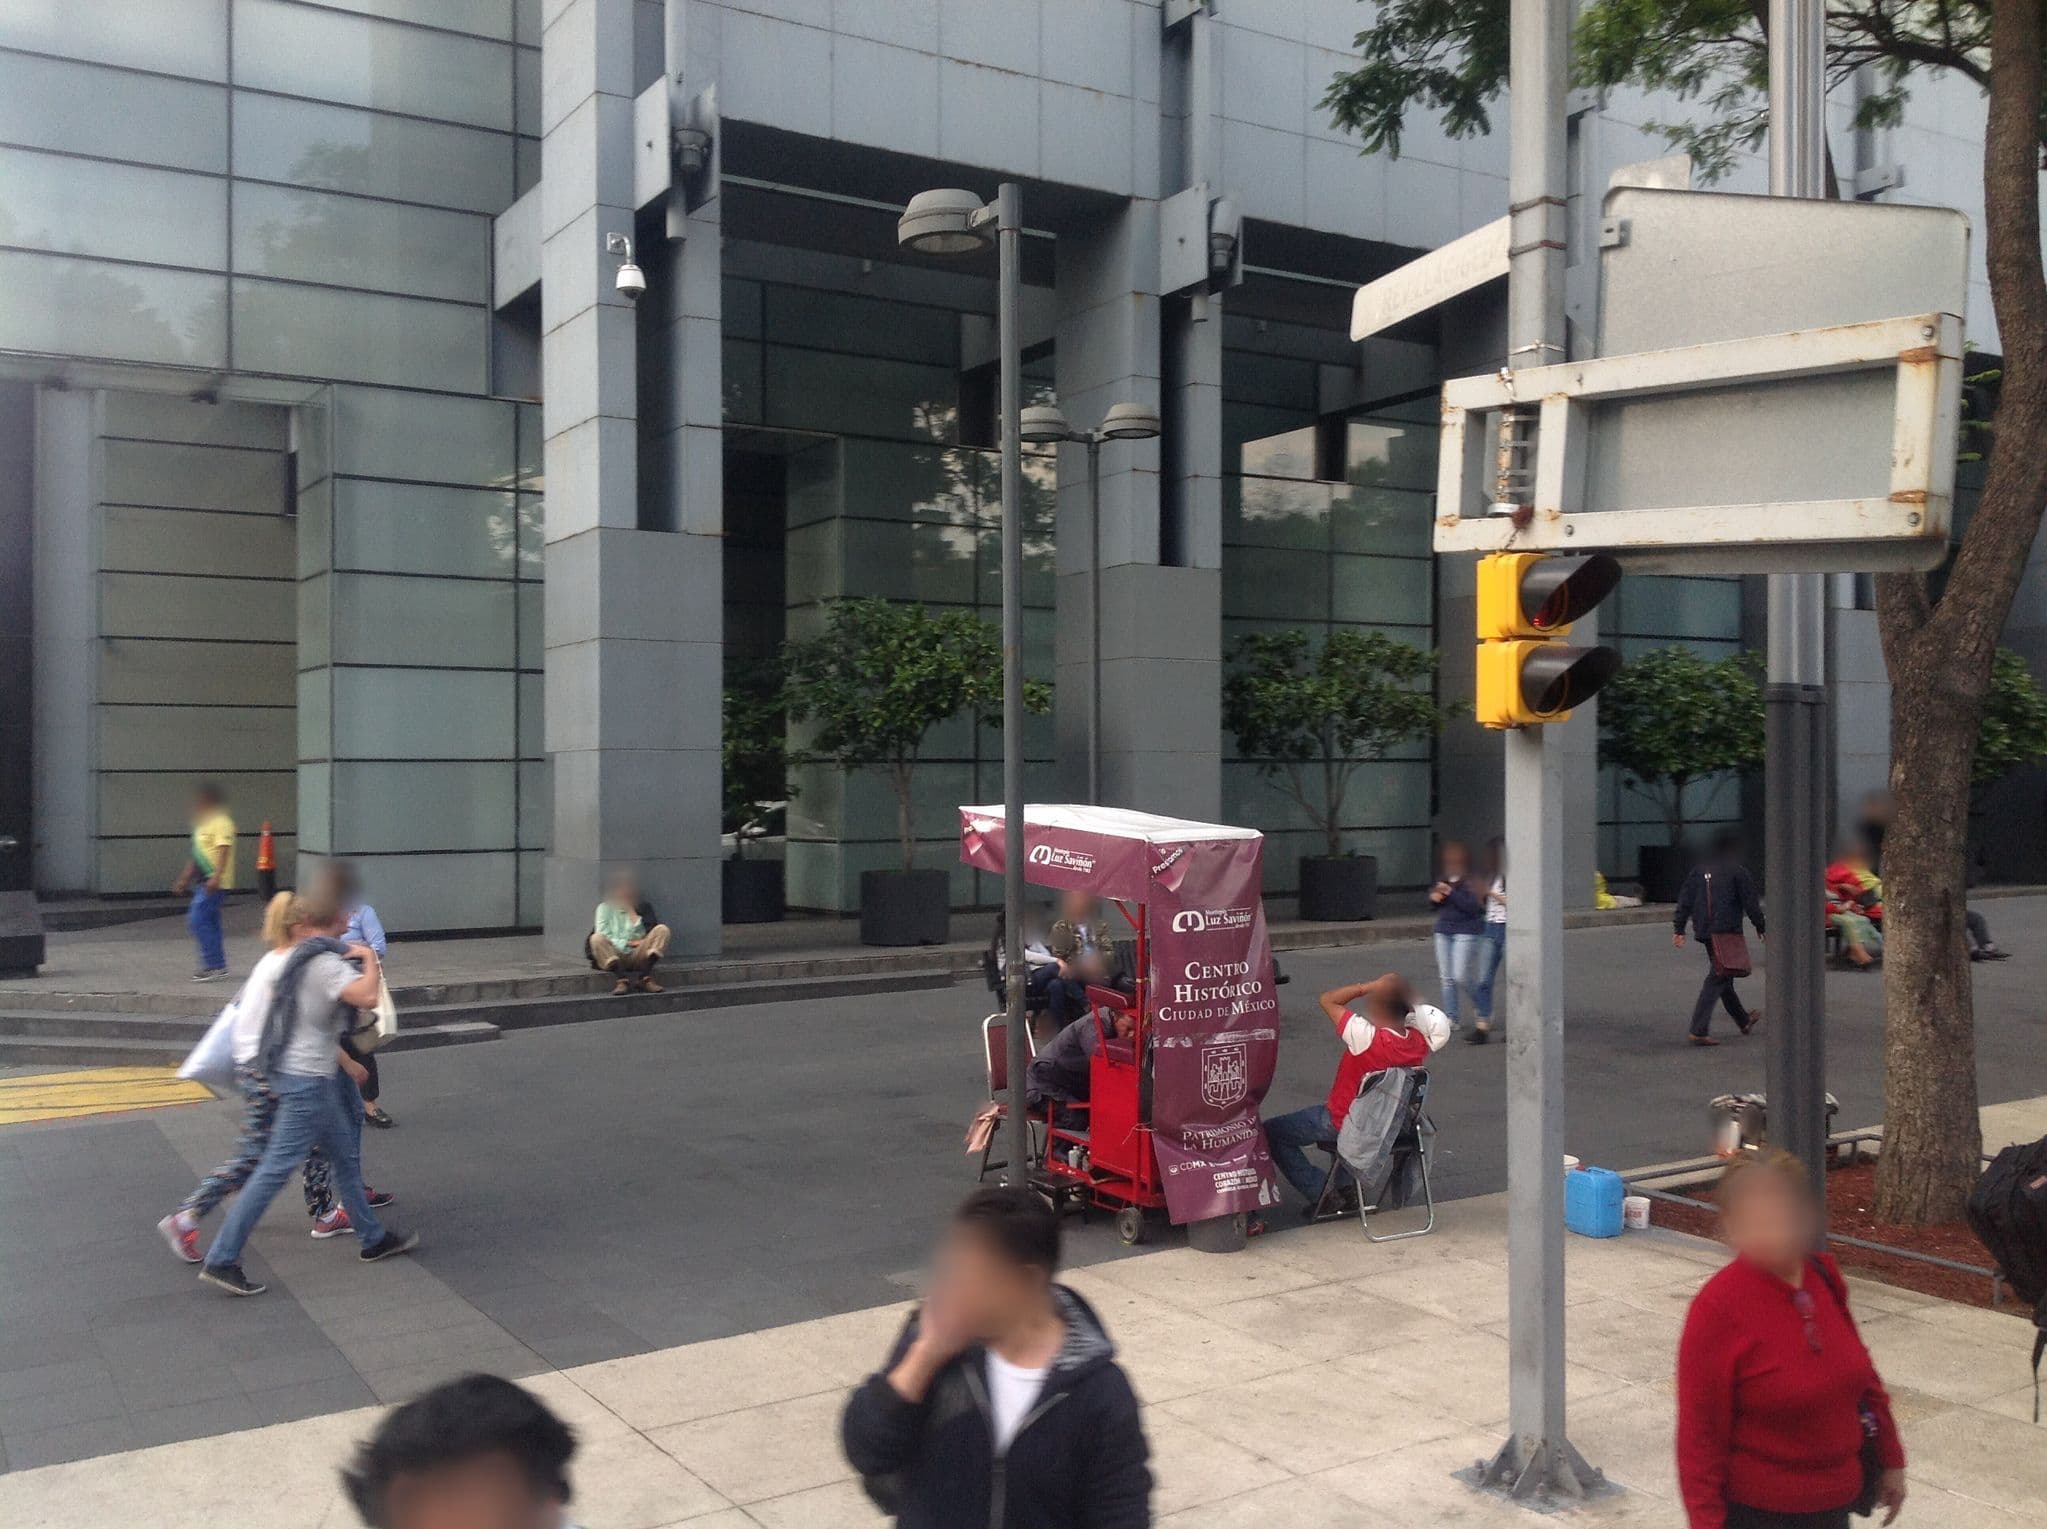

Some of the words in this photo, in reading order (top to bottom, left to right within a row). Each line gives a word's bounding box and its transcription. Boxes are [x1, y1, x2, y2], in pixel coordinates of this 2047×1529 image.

[1051, 850, 1064, 863] Luz
[1205, 915, 1222, 925] Luz
[1185, 961, 1249, 980] CENTRO
[1173, 980, 1262, 1003] HISTÓRICO
[1159, 1007, 1213, 1021] CIUDAD
[1217, 1007, 1230, 1017] DE
[1231, 999, 1275, 1015] MÉXICO
[1180, 1160, 1207, 1171] CDMX
